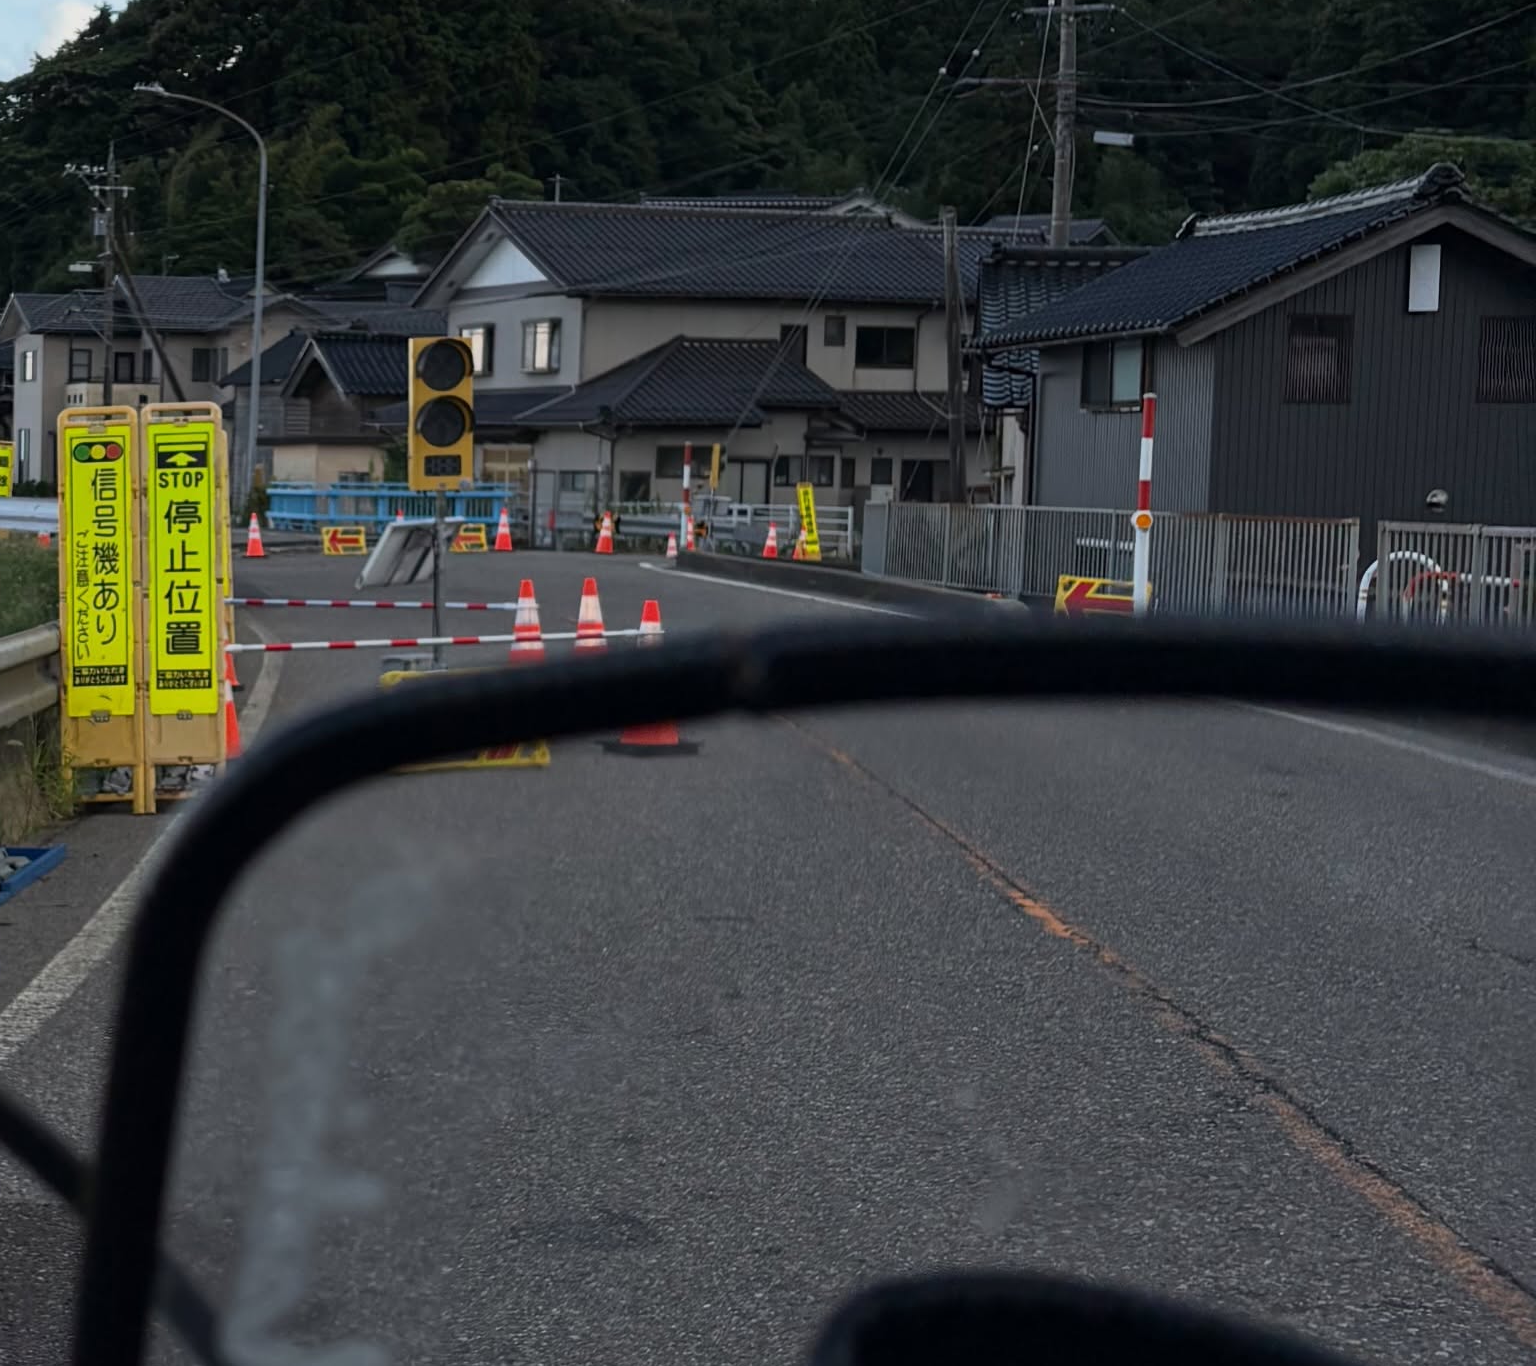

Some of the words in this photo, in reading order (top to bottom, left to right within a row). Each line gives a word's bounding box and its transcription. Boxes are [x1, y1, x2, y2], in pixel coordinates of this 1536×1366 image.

[91, 468, 120, 645] 信号機あり
[158, 471, 204, 488] STOP
[163, 499, 204, 656] 停止位置
